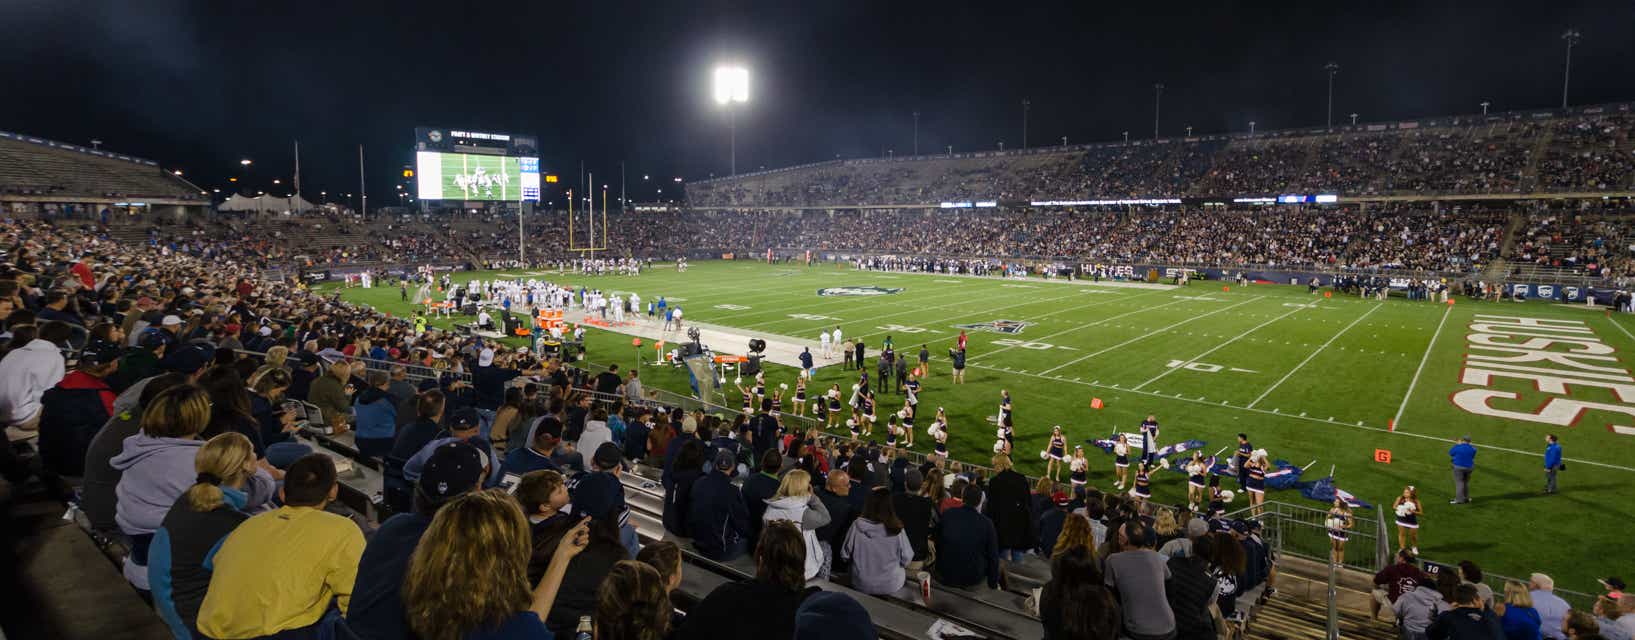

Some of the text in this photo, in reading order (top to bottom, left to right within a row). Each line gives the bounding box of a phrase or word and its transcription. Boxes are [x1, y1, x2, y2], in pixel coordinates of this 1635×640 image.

[1081, 264, 1134, 275] HUSES
[1165, 359, 1225, 373] 10
[1448, 314, 1635, 436] HUSKIES
[1427, 565, 1440, 574] 10
